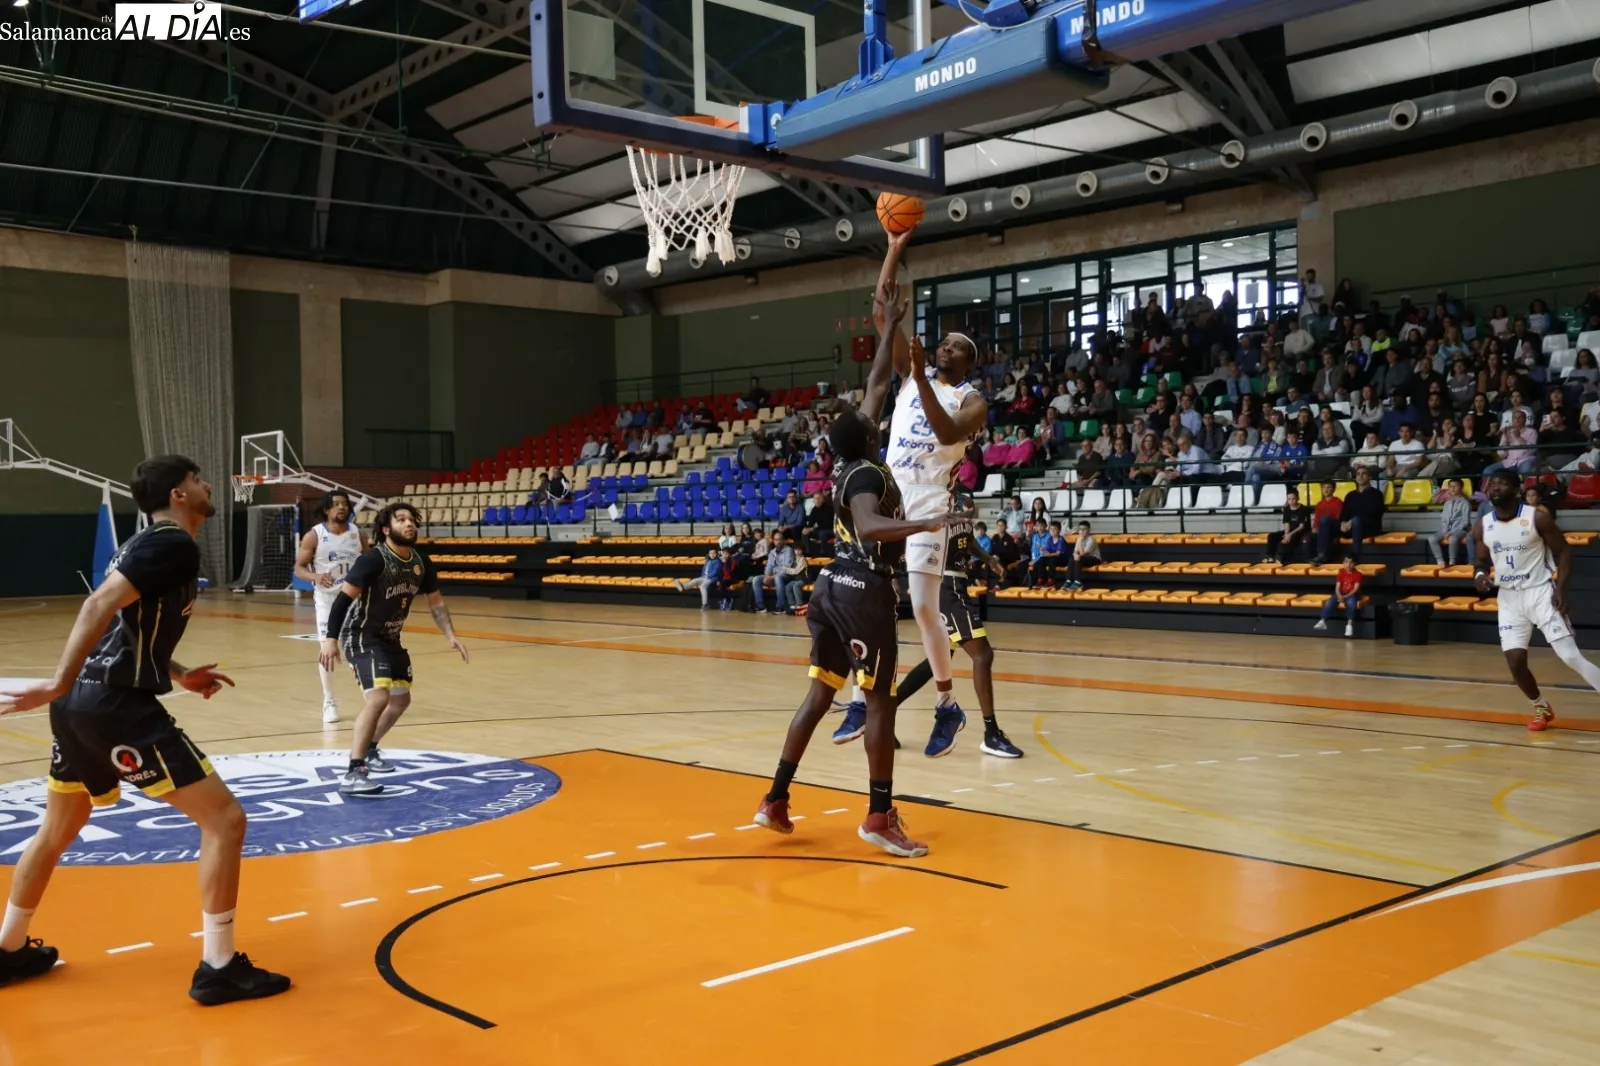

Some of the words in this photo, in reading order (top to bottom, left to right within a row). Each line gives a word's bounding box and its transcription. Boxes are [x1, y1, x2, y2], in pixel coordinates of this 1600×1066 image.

[1069, 0, 1146, 36] MNDO
[914, 57, 977, 92] MONDO
[910, 414, 934, 437] 25
[1505, 555, 1515, 569] 4
[60, 844, 264, 863] RENTIG
[274, 818, 454, 852] NUEVOS
[445, 812, 478, 821] Y
[469, 782, 547, 814] USADOS
